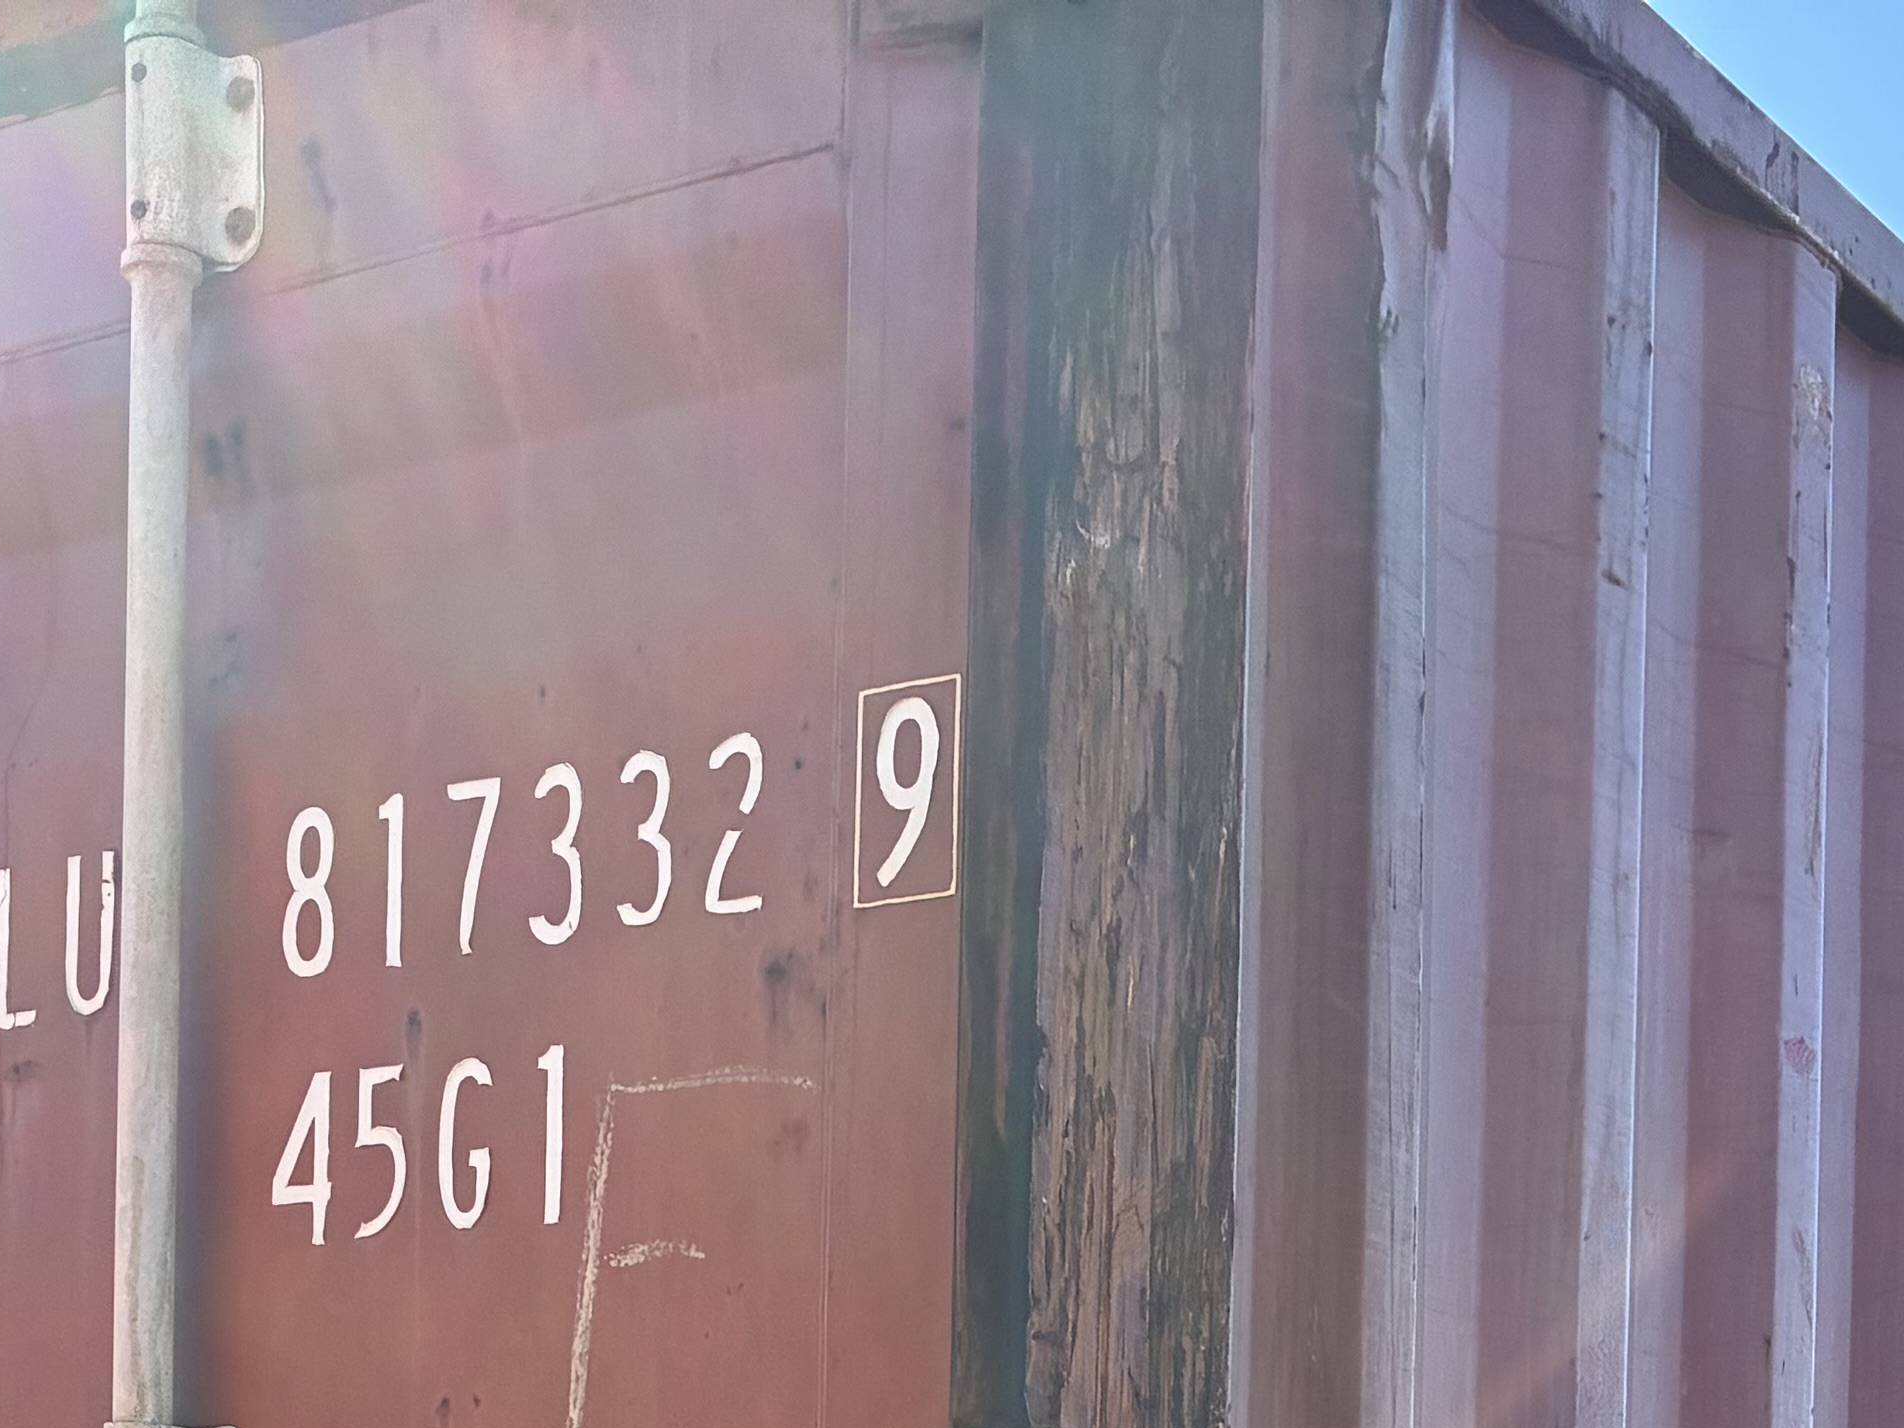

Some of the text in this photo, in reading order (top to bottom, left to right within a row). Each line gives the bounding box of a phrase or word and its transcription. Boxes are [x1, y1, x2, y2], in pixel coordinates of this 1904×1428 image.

[282, 731, 764, 978] 817332
[875, 696, 940, 888] 9
[271, 1043, 565, 1246] 45G1
